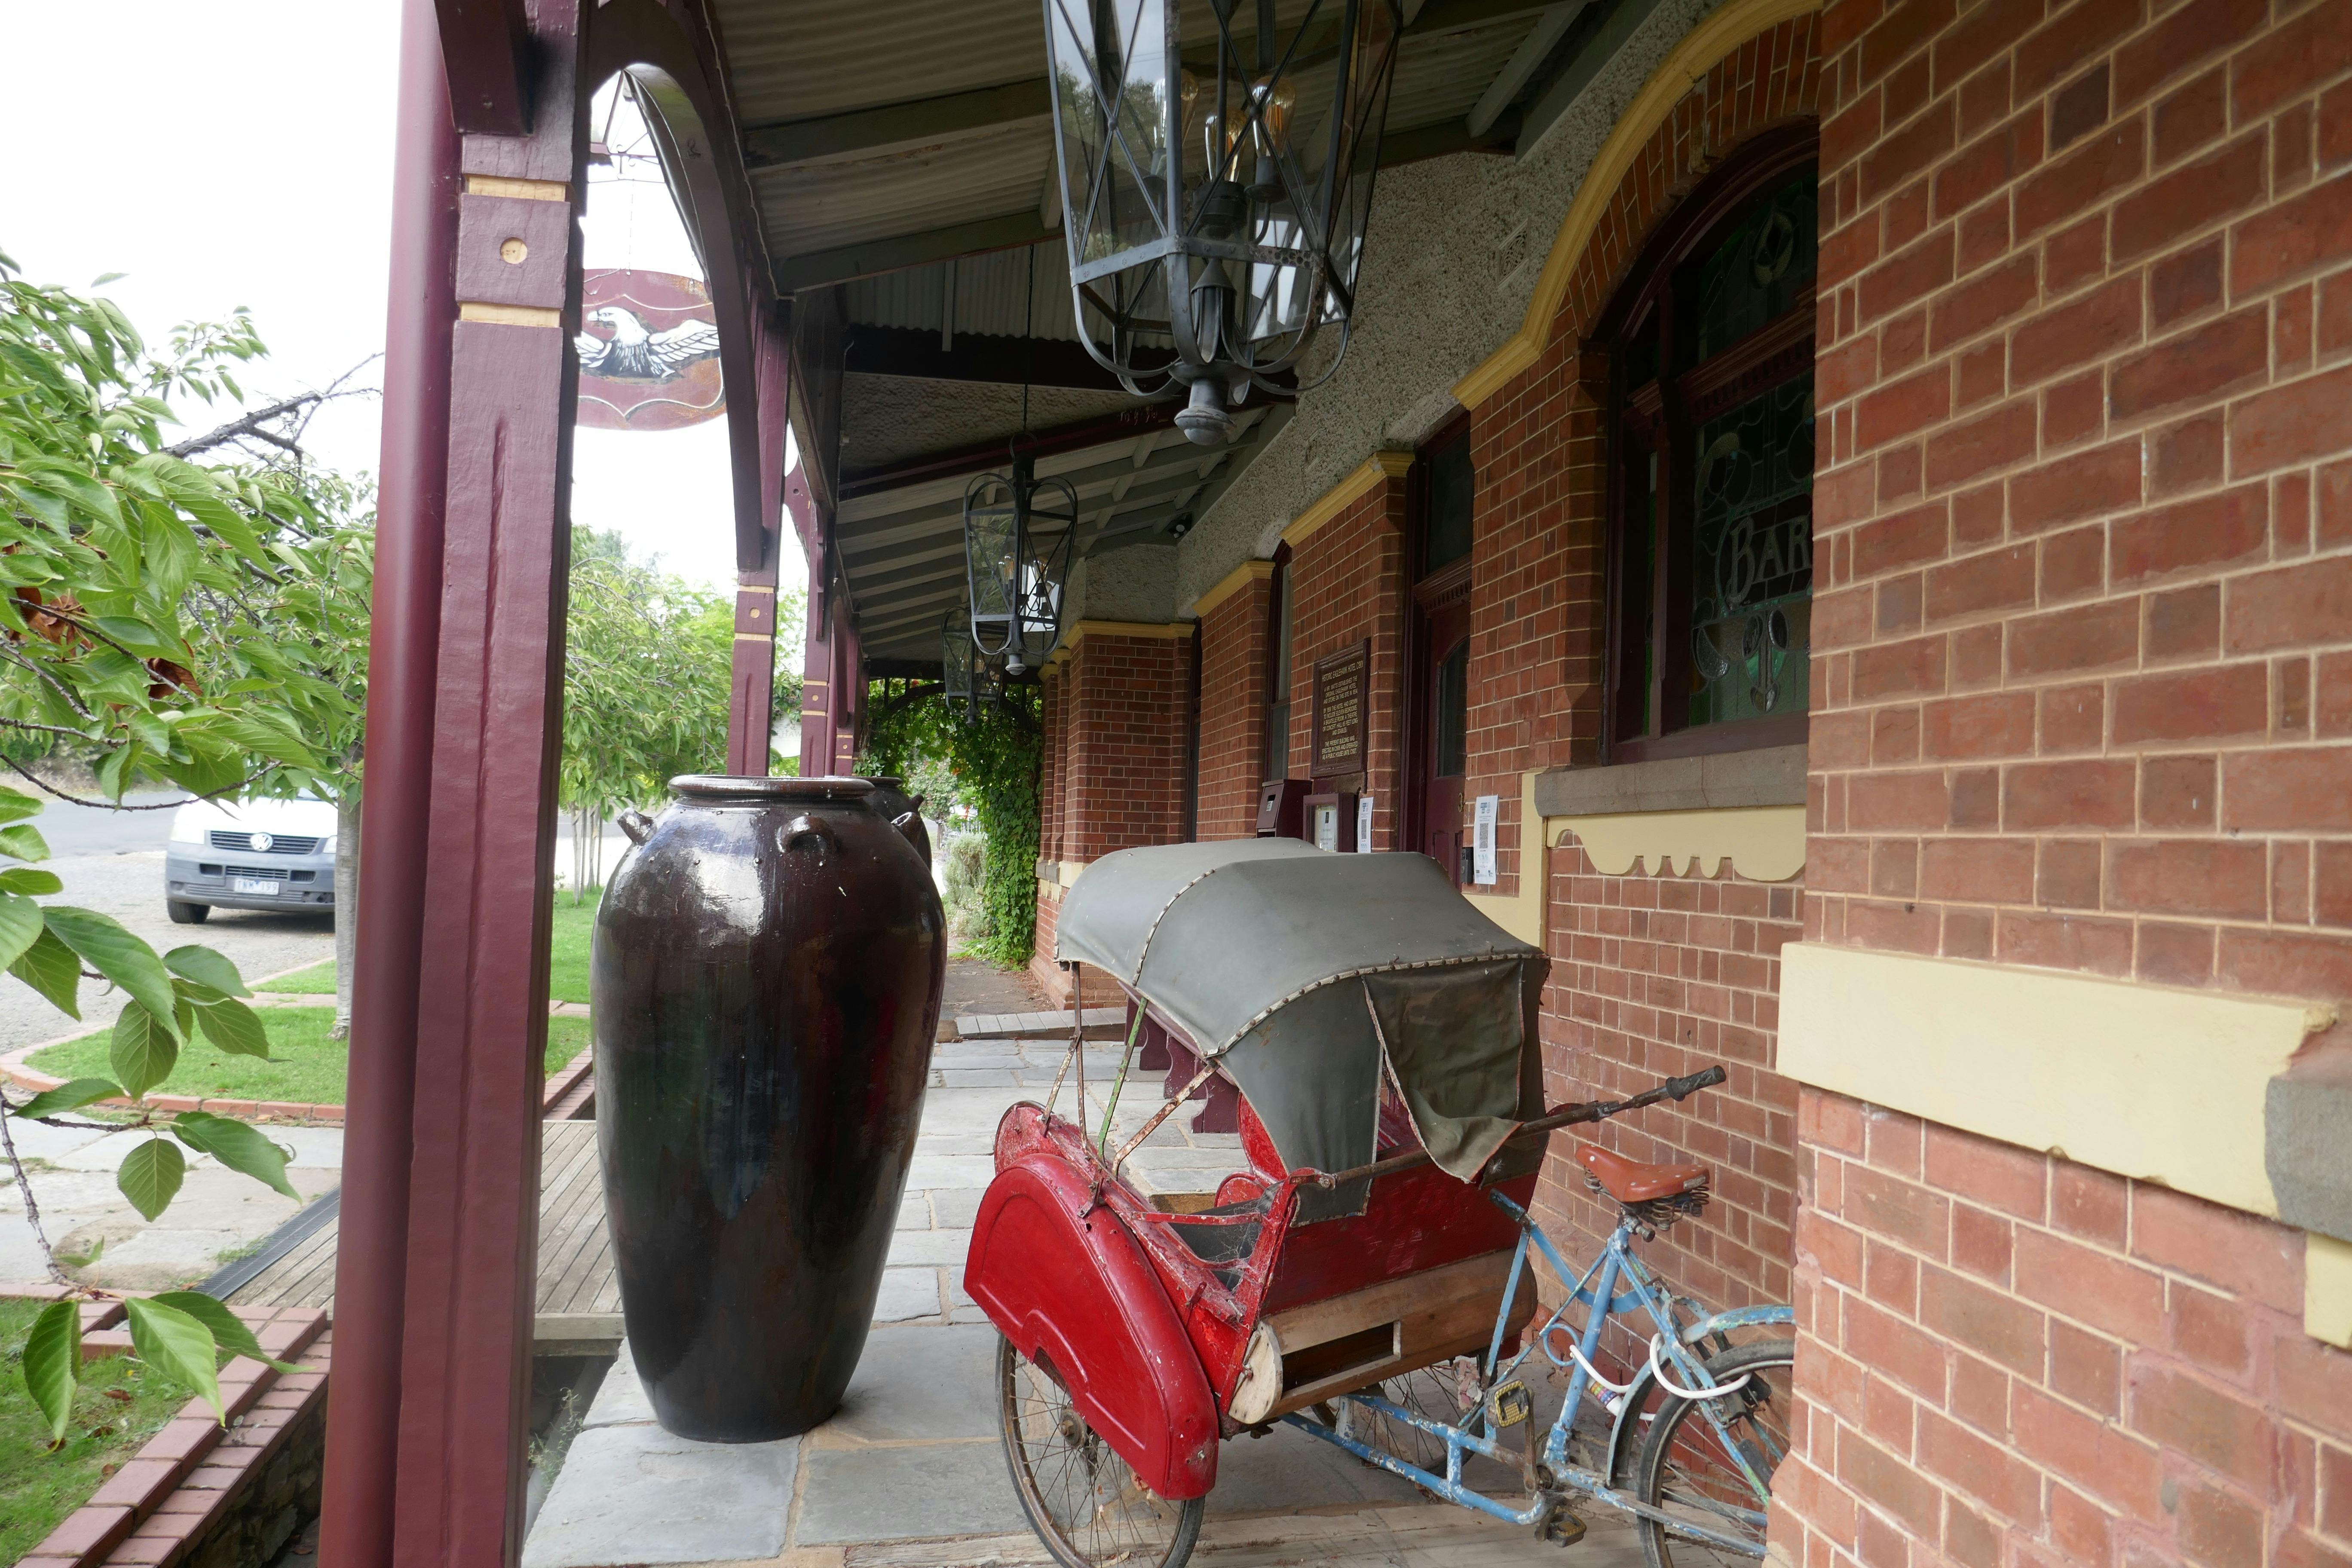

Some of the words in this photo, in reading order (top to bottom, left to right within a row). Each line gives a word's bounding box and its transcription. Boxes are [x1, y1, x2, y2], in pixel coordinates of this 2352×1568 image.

[1726, 515, 1811, 604] BAR
[1338, 677, 1353, 687] ESTABLISHED
[1325, 690, 1335, 698] ORIGINAL
[1335, 685, 1349, 695] EAGLEHAWK
[1348, 698, 1358, 706] GROWN
[1326, 723, 1336, 731] CONCERT
